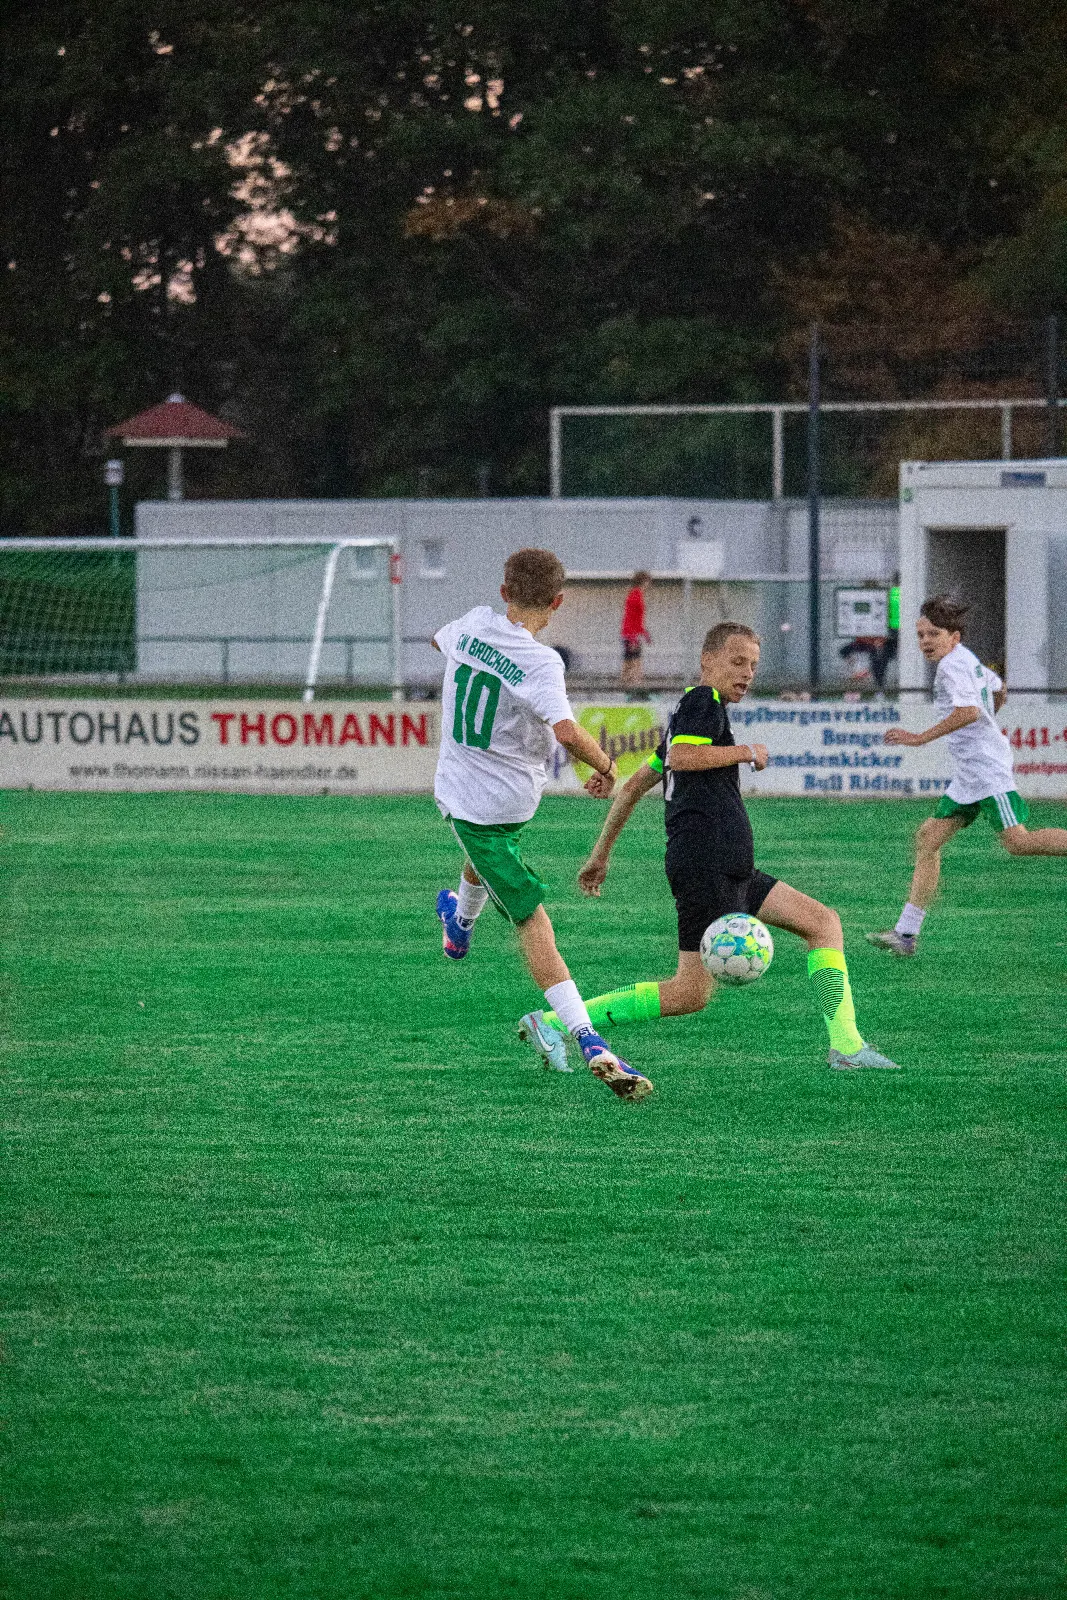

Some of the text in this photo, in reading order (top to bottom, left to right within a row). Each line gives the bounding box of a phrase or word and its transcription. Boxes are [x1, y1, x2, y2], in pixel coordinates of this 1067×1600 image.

[453, 663, 502, 750] 10
[0, 710, 430, 747] AUTOHAUS THOMANN
[823, 728, 883, 748] Bunge
[1001, 722, 1067, 748] 441-
[767, 752, 902, 768] enschenkicker
[804, 774, 843, 790] Bull
[850, 774, 913, 793] Riding
